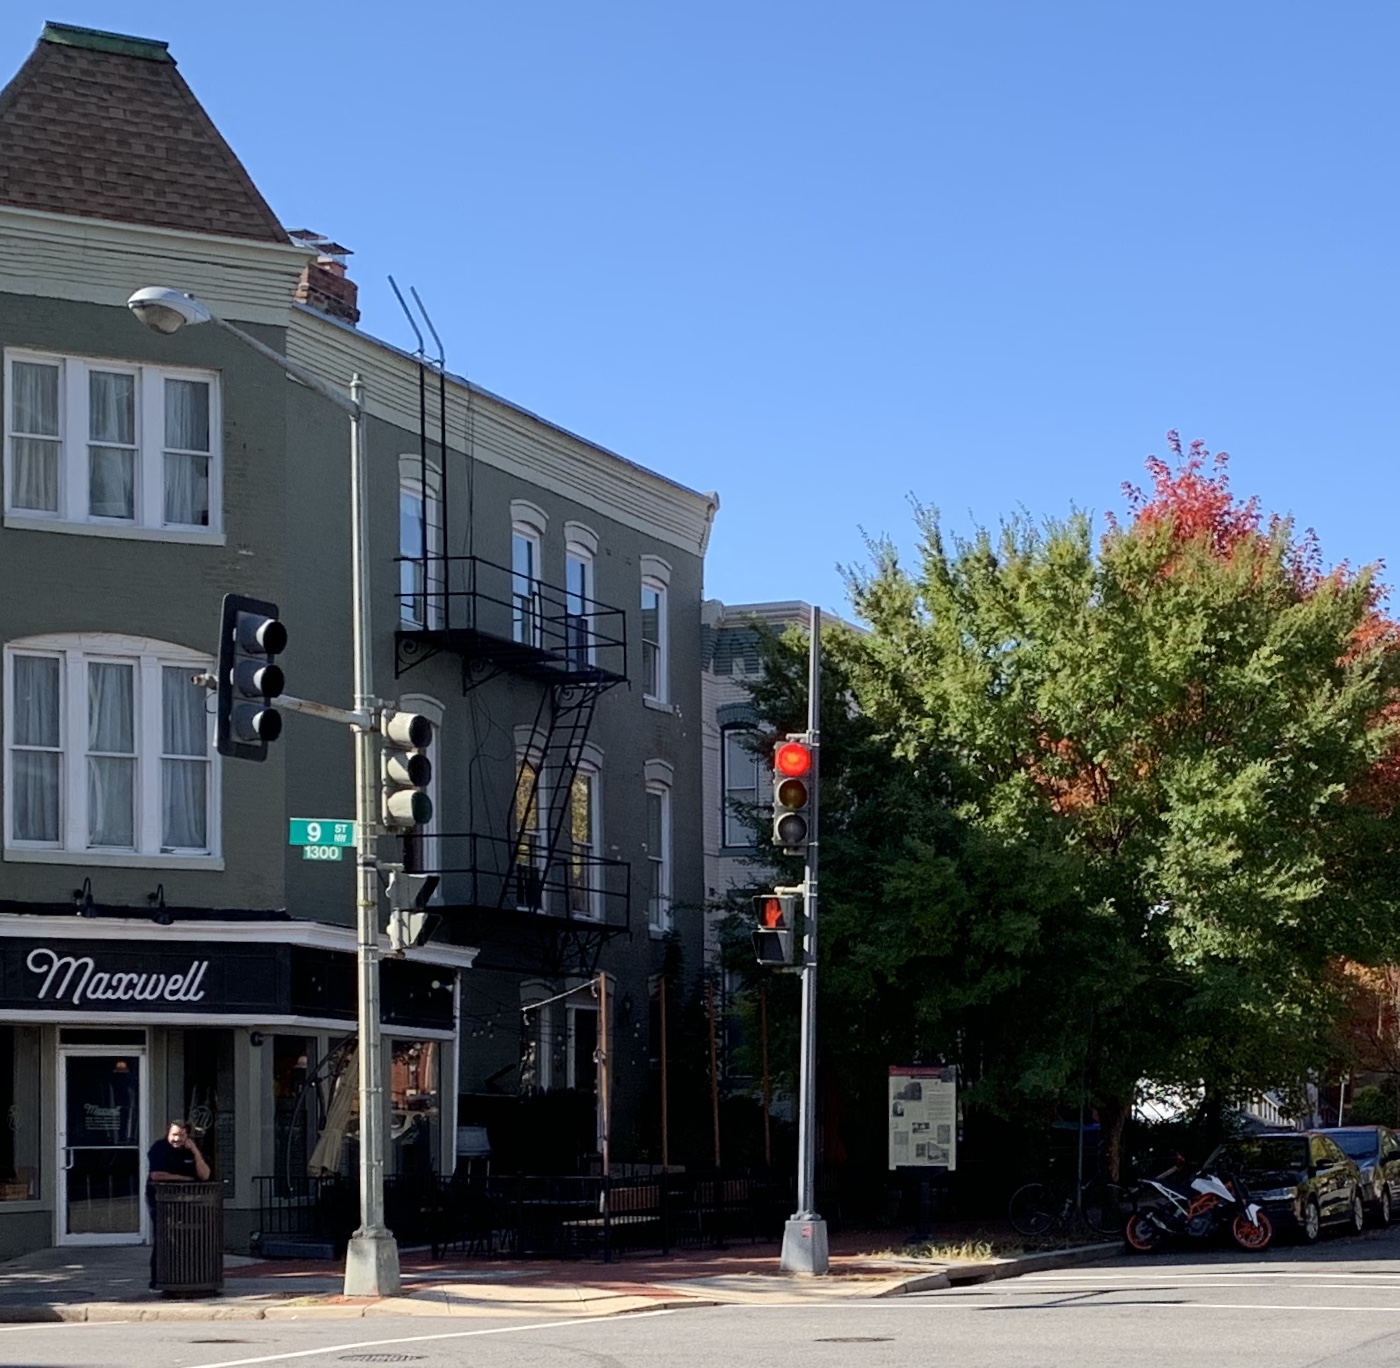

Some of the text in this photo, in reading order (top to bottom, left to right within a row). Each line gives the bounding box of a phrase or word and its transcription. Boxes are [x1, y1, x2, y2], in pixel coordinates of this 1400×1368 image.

[307, 822, 348, 842] 9 ST
[334, 834, 347, 842] NW
[304, 846, 339, 859] 1300
[26, 948, 209, 1005] Maxwell
